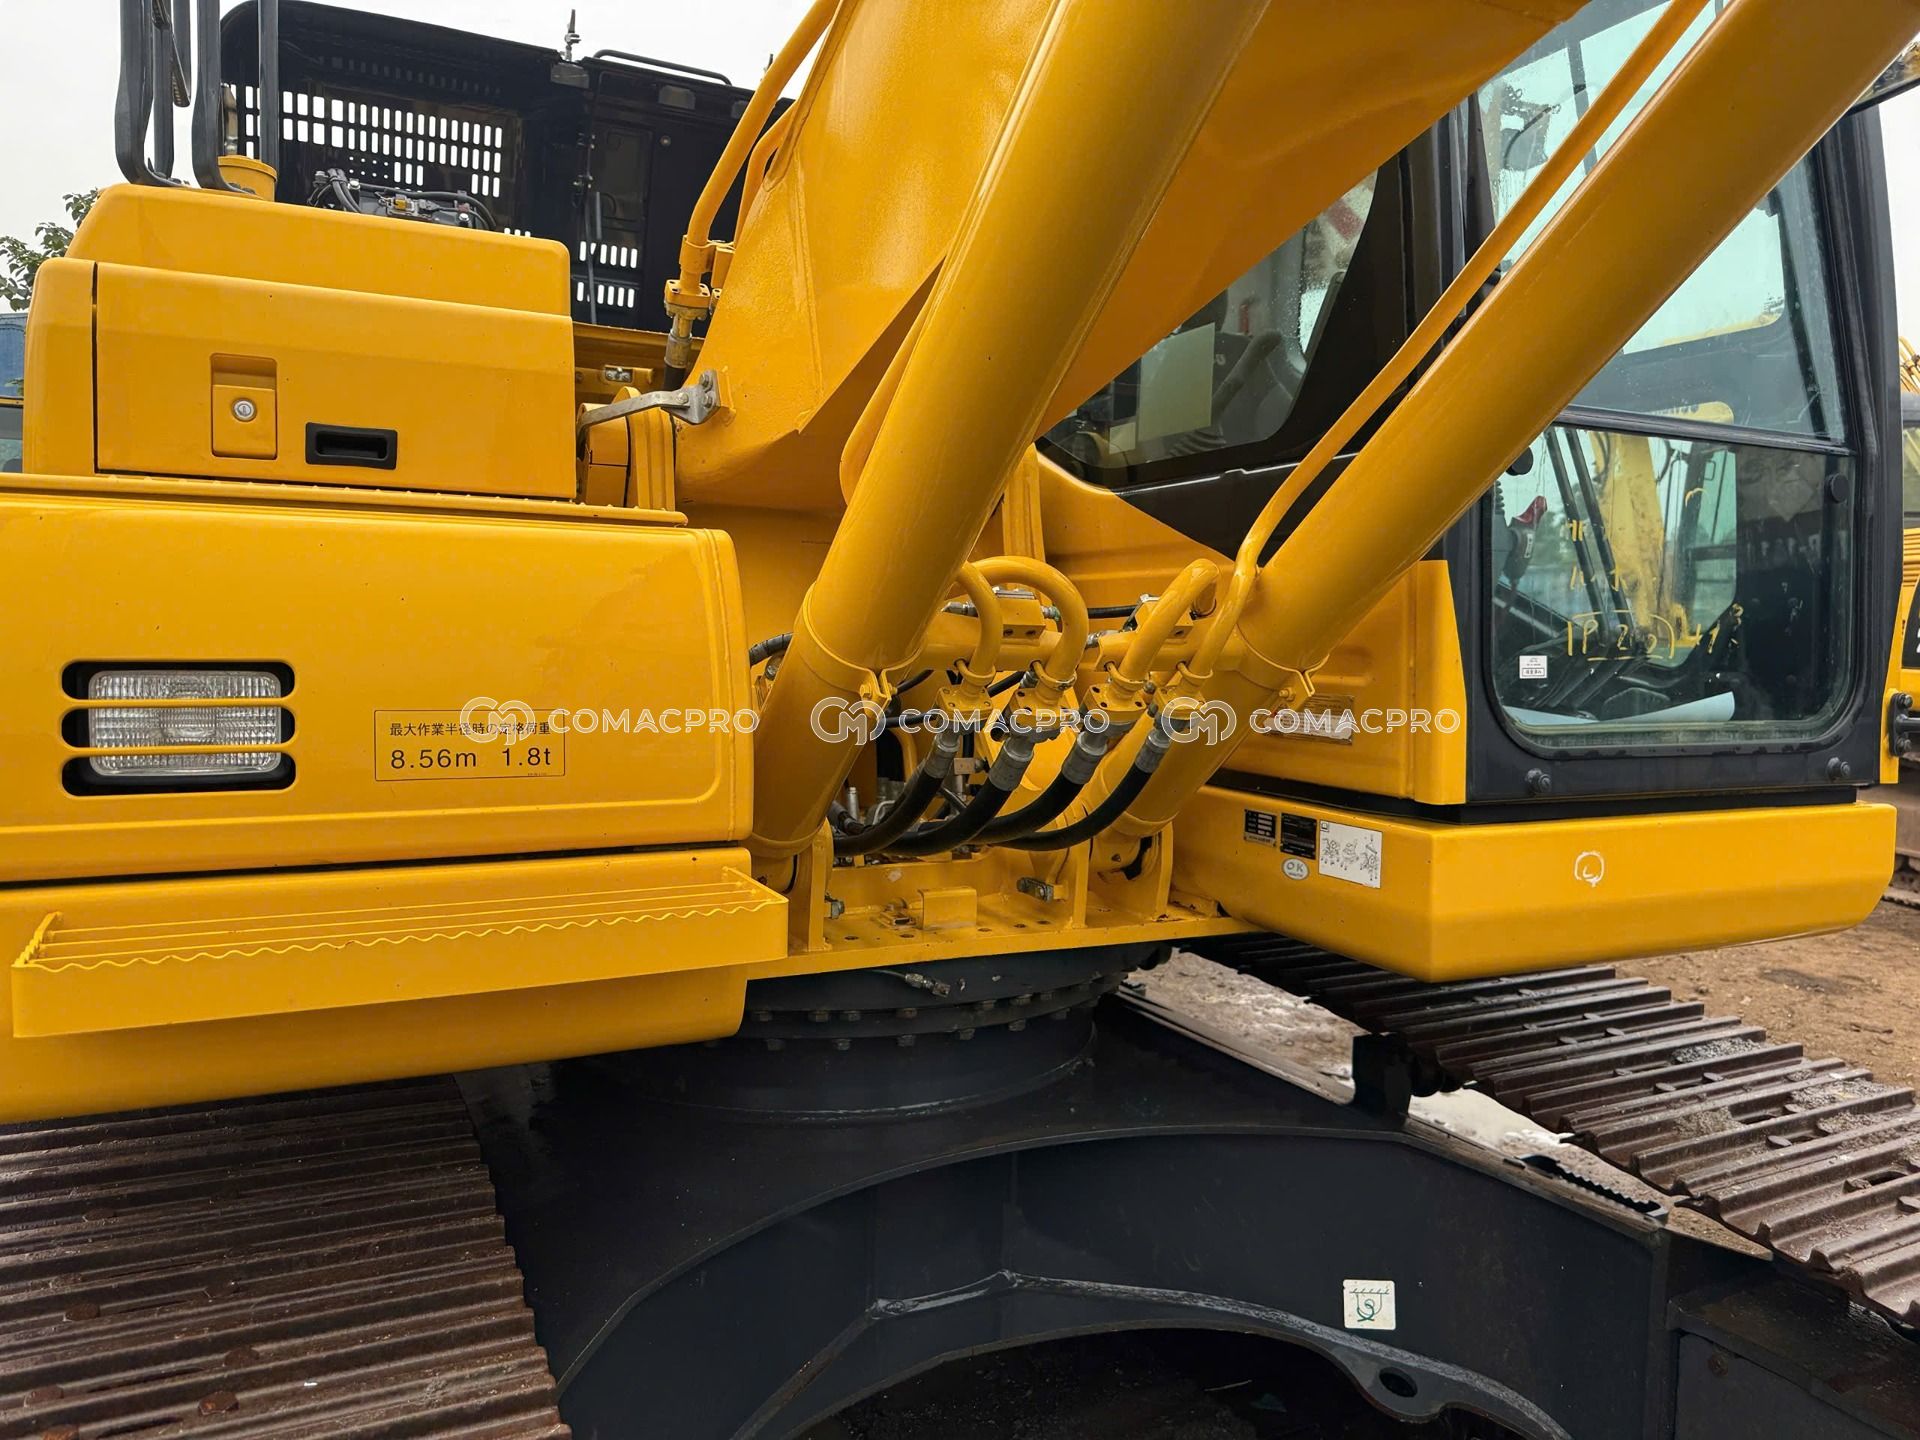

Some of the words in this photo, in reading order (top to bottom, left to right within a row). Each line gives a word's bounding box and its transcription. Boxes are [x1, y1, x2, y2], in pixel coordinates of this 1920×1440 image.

[390, 722, 551, 737] 最大作業半径時の定格荷重
[390, 748, 477, 769] 8.56m
[502, 747, 551, 766] 1.8t
[1286, 862, 1304, 873] OK
